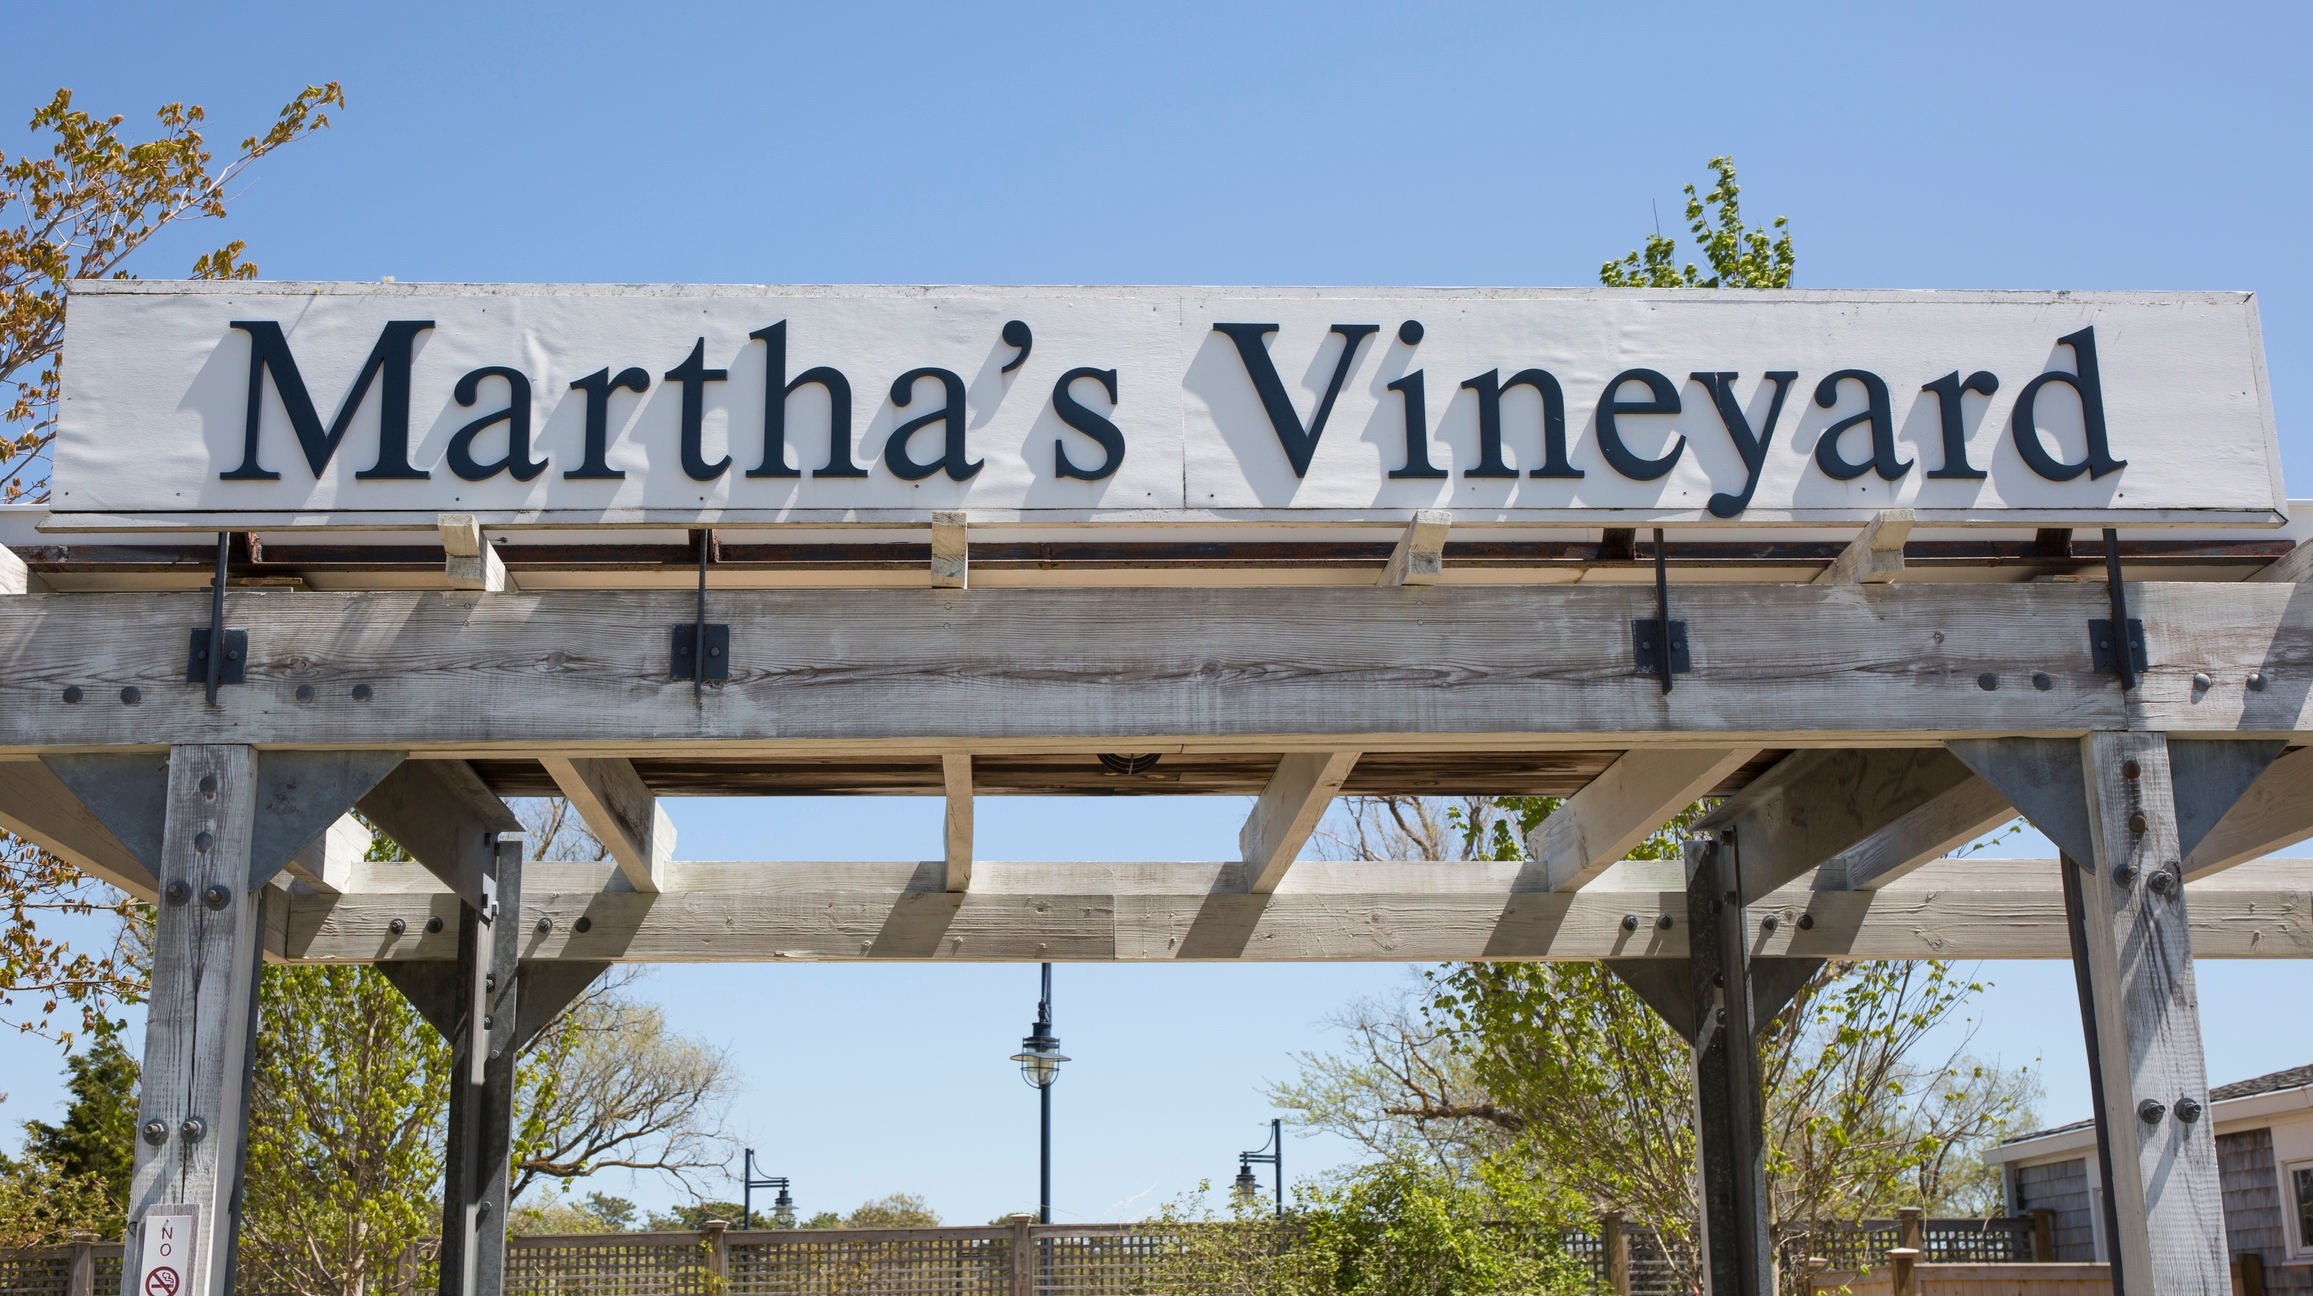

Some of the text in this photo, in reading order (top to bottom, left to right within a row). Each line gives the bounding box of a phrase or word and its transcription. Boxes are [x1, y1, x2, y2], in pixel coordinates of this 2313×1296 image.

[219, 319, 2129, 519] Martha’s Vineyard
[160, 1226, 173, 1257] NO
